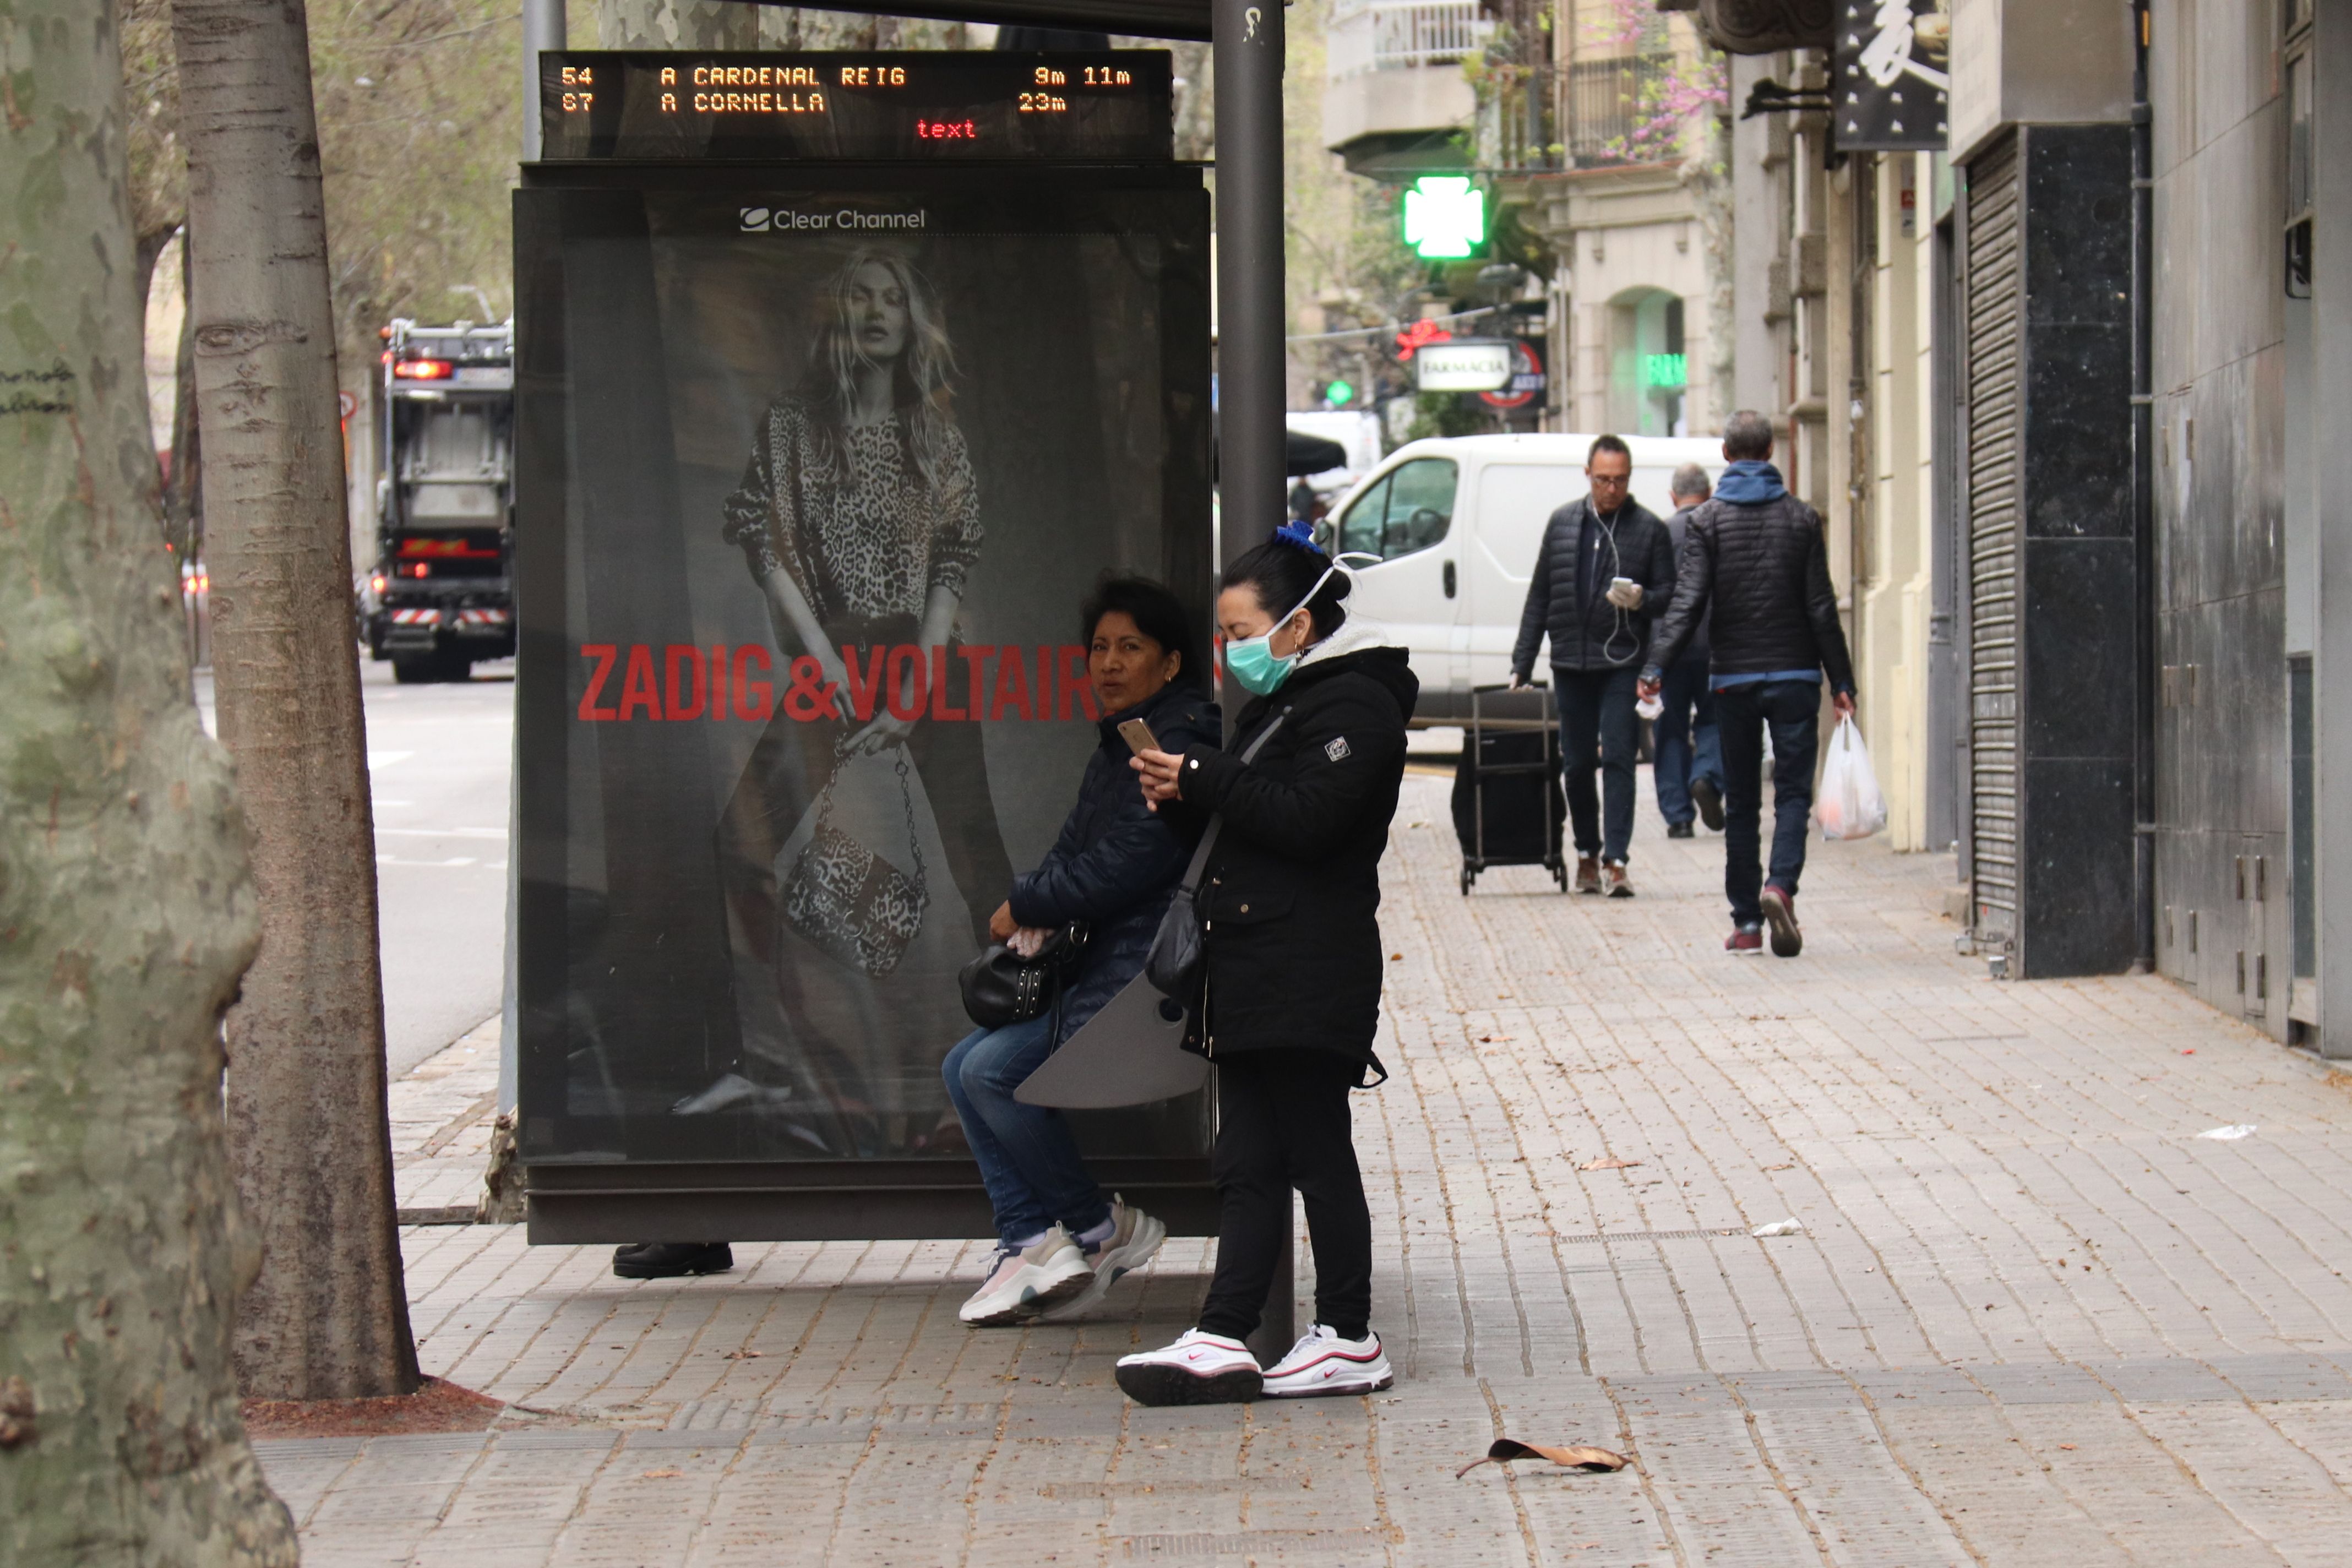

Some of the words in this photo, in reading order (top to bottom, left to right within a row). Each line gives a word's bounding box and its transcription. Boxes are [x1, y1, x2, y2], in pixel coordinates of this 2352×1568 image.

[562, 67, 593, 85] 54
[661, 67, 676, 85] A
[694, 67, 820, 86] CARDENAL
[841, 67, 905, 85] REIG
[1035, 67, 1065, 85] 9m
[1084, 67, 1130, 85] 11m
[661, 93, 677, 112] A
[694, 93, 824, 113] CORNELLA
[1019, 92, 1066, 111] 23m
[917, 119, 976, 138] text
[774, 210, 831, 229] Clear
[836, 209, 925, 229] Channel
[578, 644, 1113, 721] ZADIG&VOLTAIR
